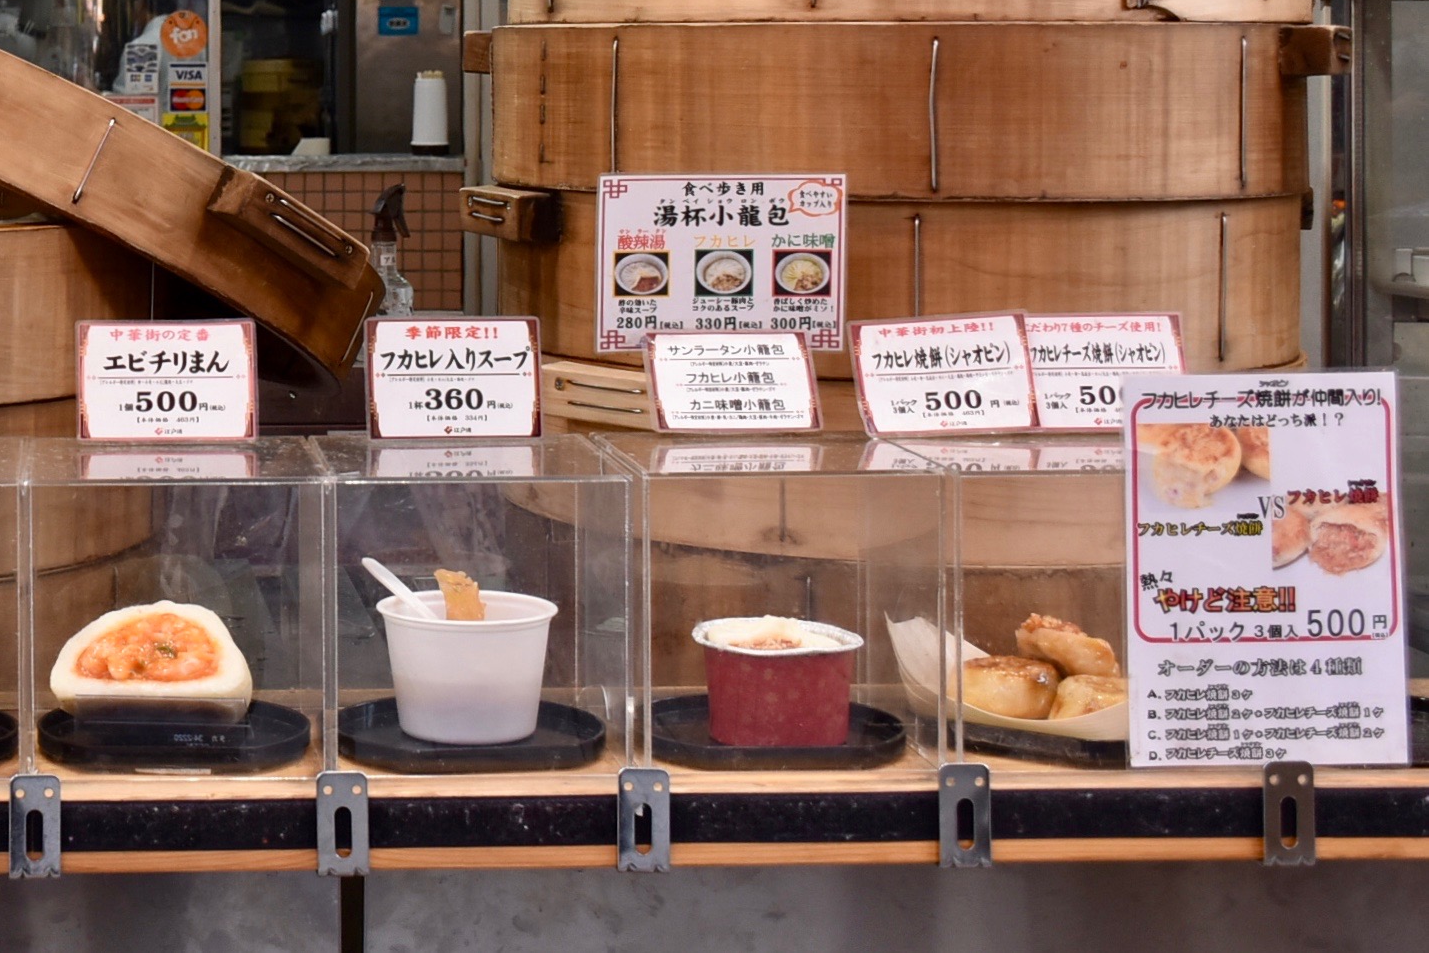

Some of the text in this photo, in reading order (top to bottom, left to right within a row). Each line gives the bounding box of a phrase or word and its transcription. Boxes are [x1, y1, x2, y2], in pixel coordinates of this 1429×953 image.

[175, 70, 202, 80] VISA
[682, 181, 764, 196] 食べ歩き用
[653, 203, 789, 227] 湯杯小龍包
[617, 233, 835, 249] 酸辣湯 フカヒレ かに味噌
[110, 328, 210, 342] 中華街の定番
[405, 326, 498, 340] 季節限定!!
[878, 322, 993, 338] 中華街初上陸!!
[380, 346, 530, 372] フカヒレ入りスープ
[668, 344, 784, 356] サンラータン小籠包
[871, 341, 1011, 370] フカヒレ焼餅(シャオピン)
[103, 350, 230, 375] エビチリまん
[686, 371, 775, 384] フカヒレ小籠包
[1079, 385, 1123, 406] 50
[1142, 388, 1381, 409] フカヒレチーズ焼餅が仲間入り!
[1258, 496, 1285, 519] VS
[1154, 586, 1296, 613] やけど注意!!
